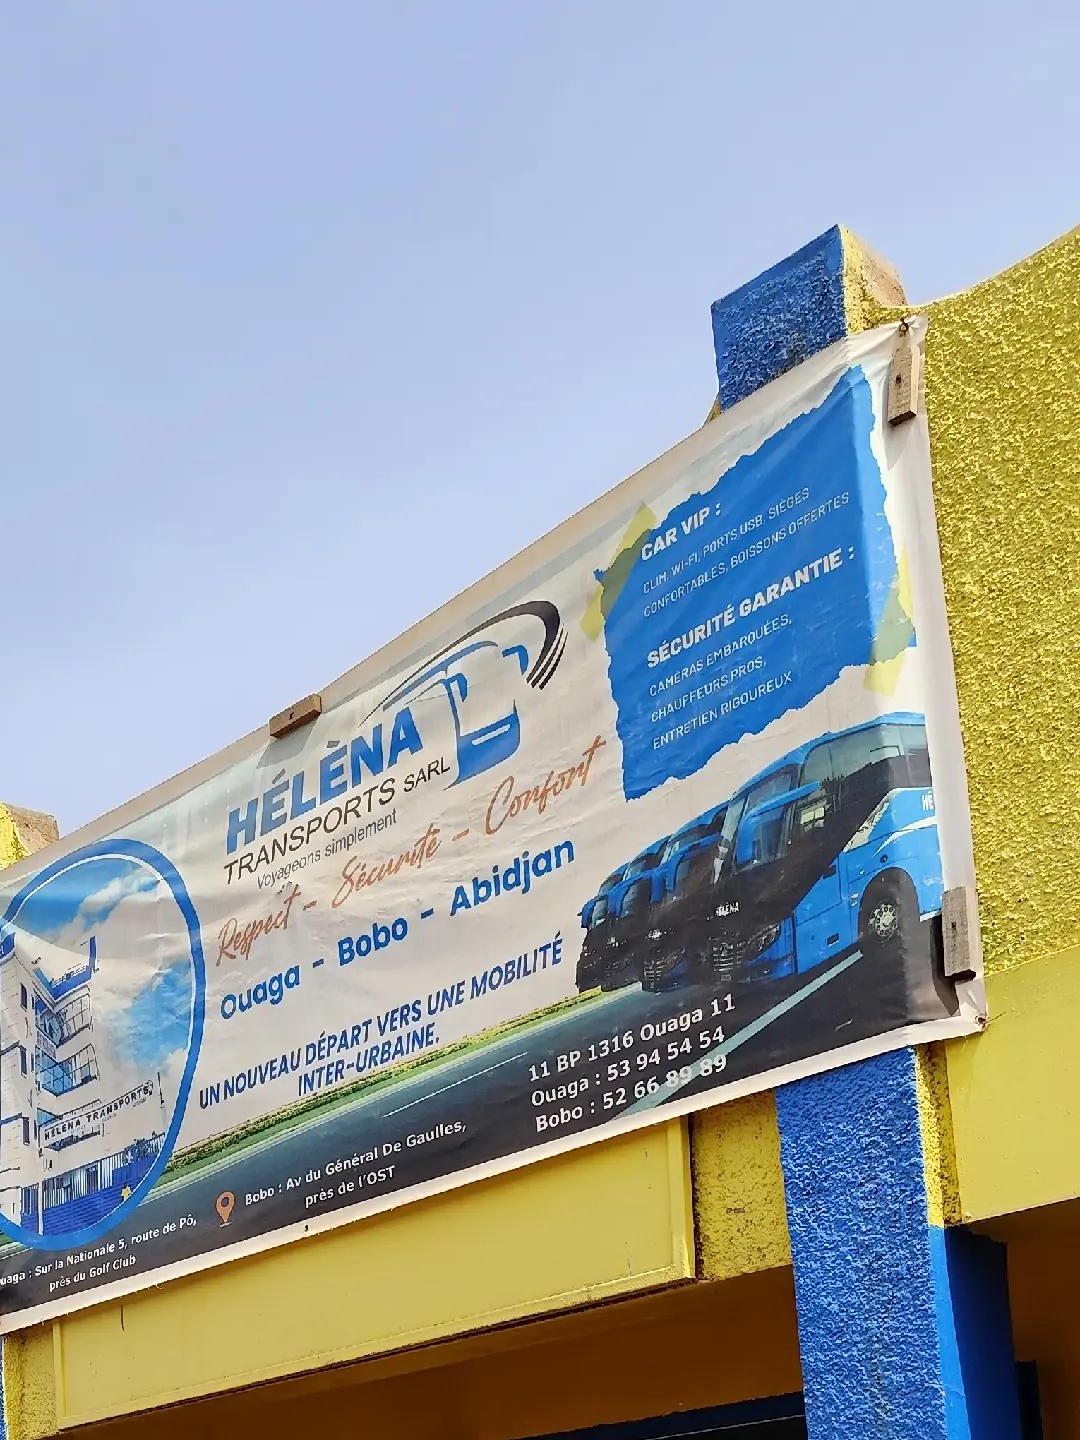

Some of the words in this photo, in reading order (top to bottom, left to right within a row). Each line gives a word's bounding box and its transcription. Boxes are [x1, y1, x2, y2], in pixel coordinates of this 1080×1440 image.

[640, 528, 678, 562] CAR
[680, 506, 711, 536] VIP
[643, 563, 729, 618] CONFORTABLES,
[730, 527, 787, 567] BOISSONS
[788, 491, 850, 535] OFFERTES
[671, 552, 701, 576] WI-FI,
[703, 529, 738, 558] PORTS
[740, 517, 766, 537] USB,
[647, 603, 736, 669] SÉCURITÉ
[739, 547, 843, 618] GARANTIE
[649, 659, 704, 697] CAMERAS
[706, 613, 792, 667] EMBARQUÉES,
[651, 675, 729, 723] CHAUFFEURS
[730, 655, 767, 682] PROS,
[653, 707, 718, 750] ENTRETIEN
[720, 670, 792, 714] RIGOUREUX
[223, 778, 395, 885] TRANSPORTS
[404, 757, 450, 792] SARL
[226, 706, 423, 855] HÉLÈNA
[216, 886, 302, 967] Respect
[331, 822, 442, 908] Sécurité
[485, 735, 607, 835] Confort
[257, 849, 321, 890] Voyageons
[325, 808, 397, 860] simplement
[220, 965, 301, 1020] Ouaga
[338, 916, 408, 967] Bobo
[449, 839, 575, 917] Abidjan
[199, 1082, 221, 1110] UN
[223, 1049, 301, 1101] NOUVEAU
[305, 1017, 373, 1066] DÉPART
[376, 999, 422, 1037] VERS
[427, 980, 466, 1016] UNE
[470, 932, 563, 1000] MOBILITÉ
[297, 1022, 440, 1097] INTER-URBAINE.
[528, 1061, 551, 1082] 11
[557, 1050, 581, 1073] BP
[588, 1030, 634, 1062] 1316
[640, 1007, 703, 1041] Ouaga
[710, 993, 736, 1017] 11
[86, 1085, 149, 1123] TRANSPORTS
[531, 1077, 589, 1107] Ouaga
[607, 1059, 631, 1081] 53
[636, 1048, 661, 1072] 94
[667, 1037, 693, 1061] 54
[699, 1026, 725, 1049] 54
[535, 1105, 583, 1133] Bobo
[603, 1088, 627, 1110] 52
[634, 1076, 661, 1099] 66
[666, 1065, 693, 1088] 89
[699, 1054, 727, 1078] 89
[245, 1187, 275, 1206] Bobo
[286, 1177, 302, 1192] Av
[305, 1169, 321, 1184] du
[325, 1148, 378, 1176] Général
[383, 1142, 402, 1157] De
[406, 1120, 467, 1147] Gaulles,
[305, 1186, 334, 1209] près
[337, 1180, 355, 1195] de
[35, 1264, 53, 1277] Sur
[55, 1258, 64, 1270] la
[67, 1243, 115, 1267] Nationale
[118, 1239, 128, 1251] 5,
[131, 1228, 160, 1245] route
[162, 1221, 177, 1235] de
[179, 1214, 197, 1229] Pô,
[49, 1275, 71, 1293] près
[73, 1268, 86, 1283] du
[89, 1262, 110, 1277] Golf
[113, 1254, 136, 1271] Club
